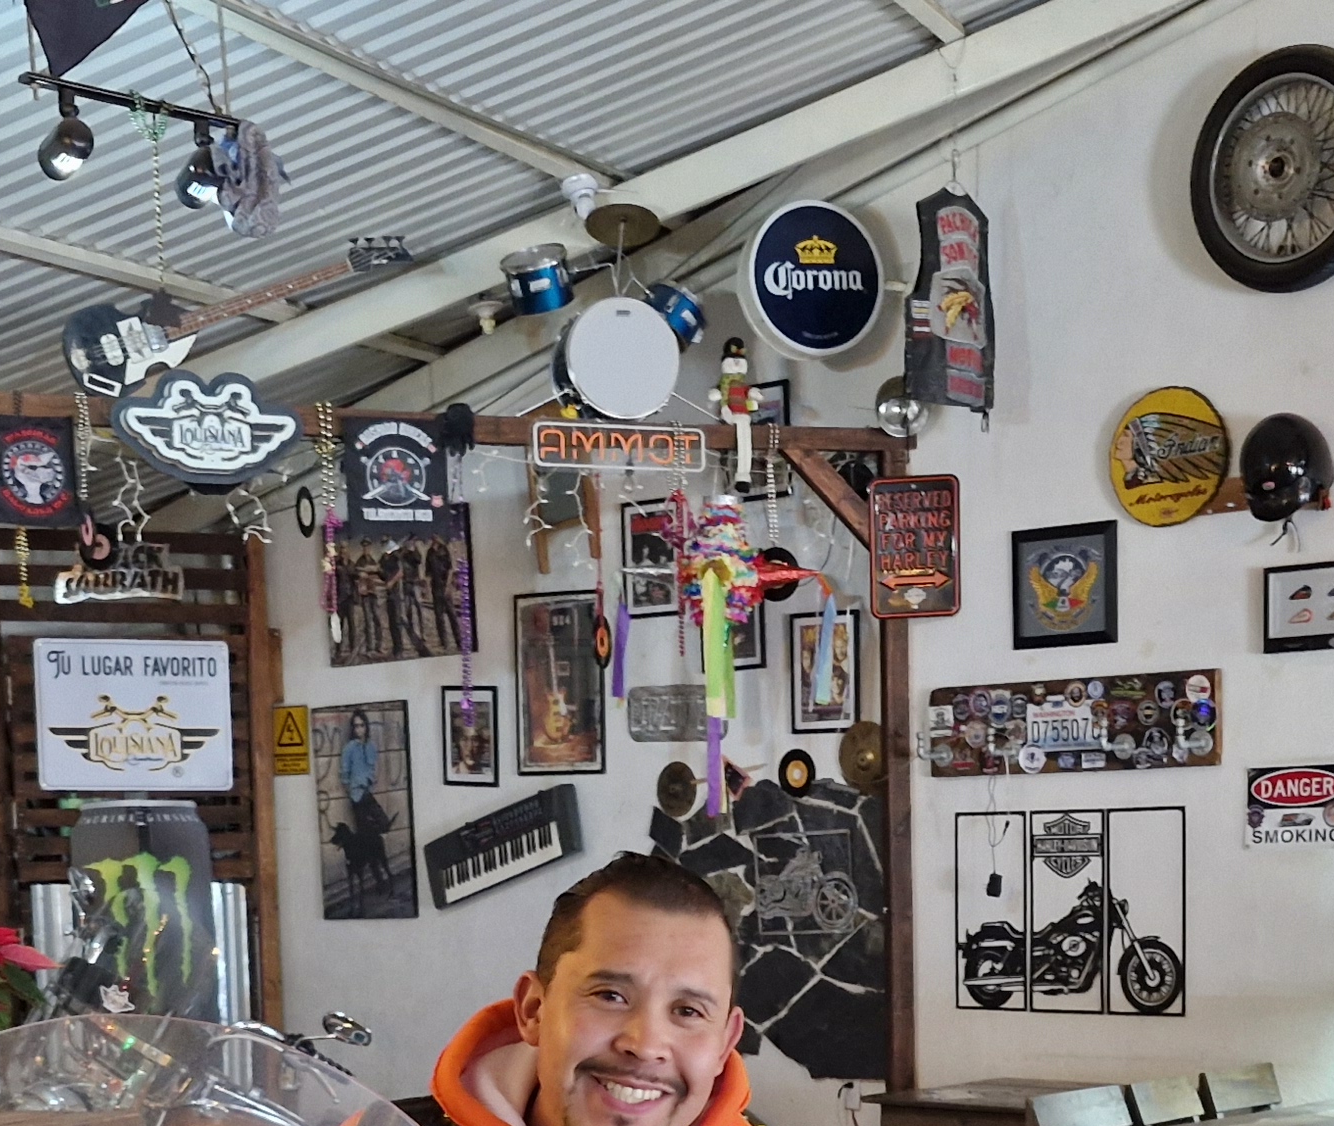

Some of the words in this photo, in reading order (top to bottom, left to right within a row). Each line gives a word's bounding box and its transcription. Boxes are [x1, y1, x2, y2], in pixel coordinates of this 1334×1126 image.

[764, 260, 864, 300] Corona
[877, 489, 952, 511] RESERVED
[878, 509, 952, 531] PARKING
[880, 531, 916, 551] FOR
[923, 530, 948, 549] MY
[880, 549, 949, 571] HARLEY
[47, 650, 71, 679] TU
[81, 655, 134, 677] LUGAR
[143, 655, 218, 678] FAVORITO
